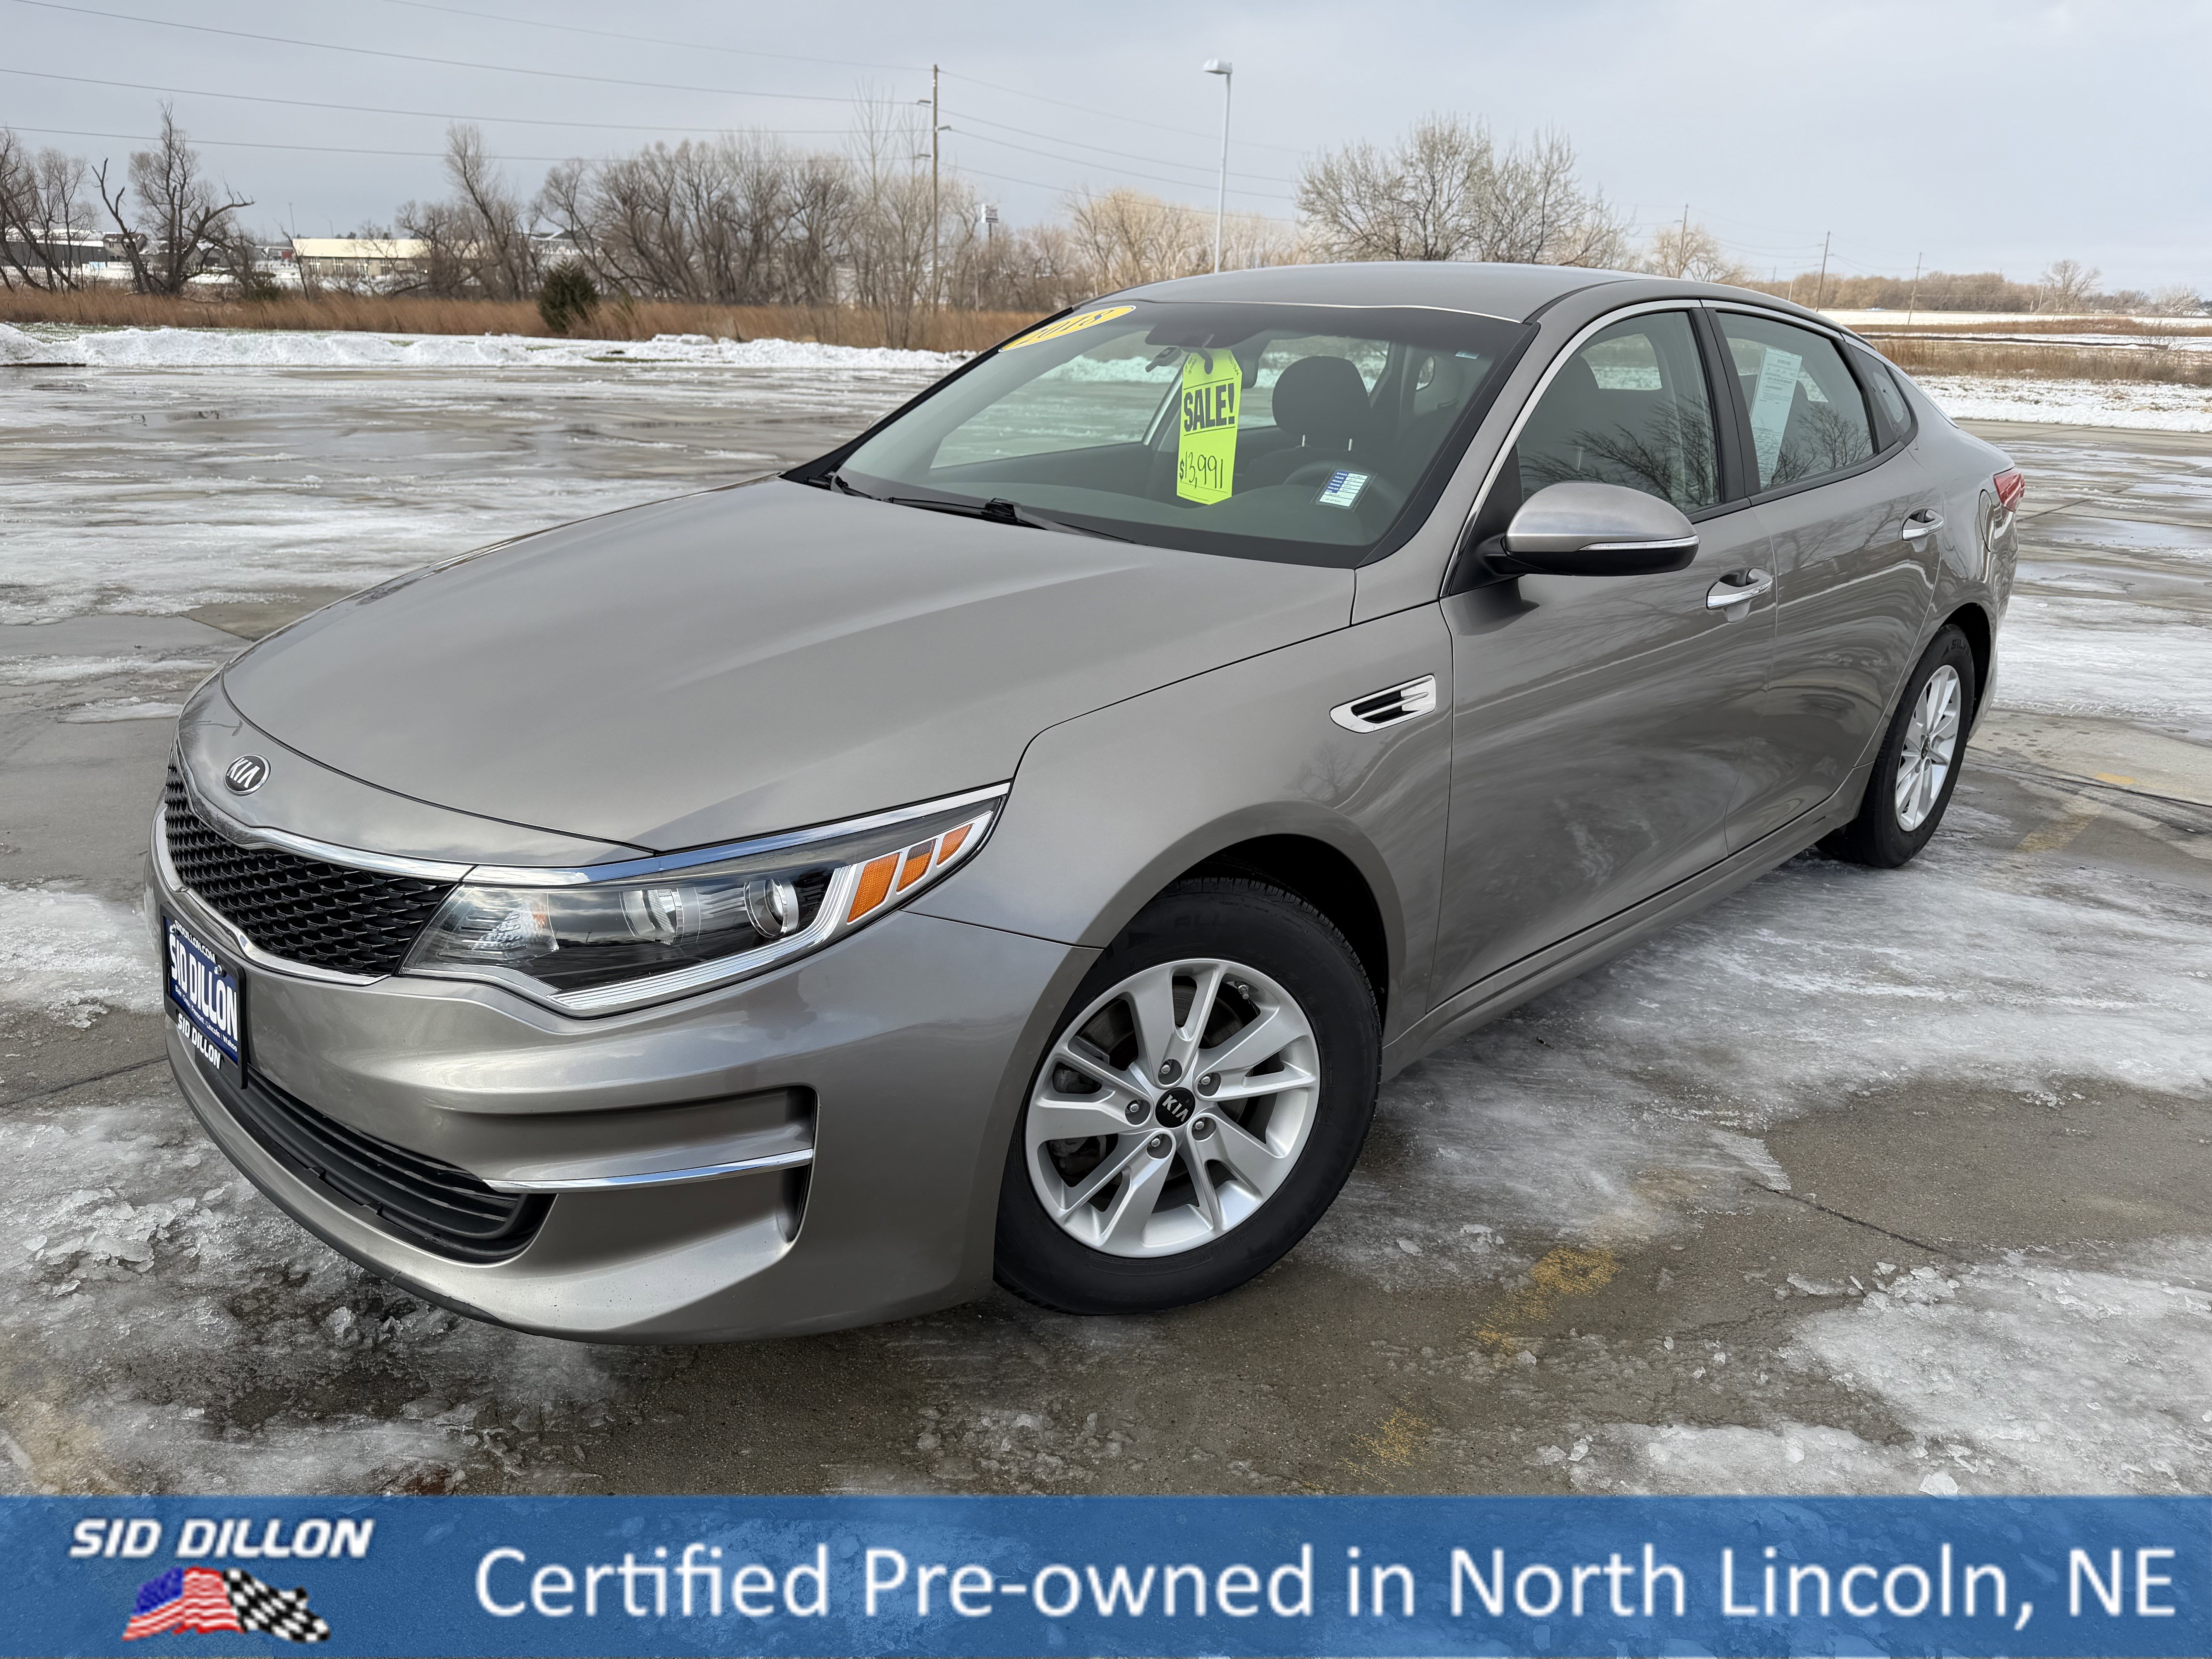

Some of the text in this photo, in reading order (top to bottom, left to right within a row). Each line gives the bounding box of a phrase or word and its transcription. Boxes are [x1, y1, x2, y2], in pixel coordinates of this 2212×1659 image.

[1184, 383, 1235, 432] SALE!
[1179, 451, 1223, 489] $13,991
[227, 757, 261, 788] KIA
[169, 933, 238, 1042] SID DILLON
[178, 1013, 221, 1070] SID DILLON
[223, 1034, 237, 1052] Wahoo
[1162, 1094, 1189, 1122] KIA
